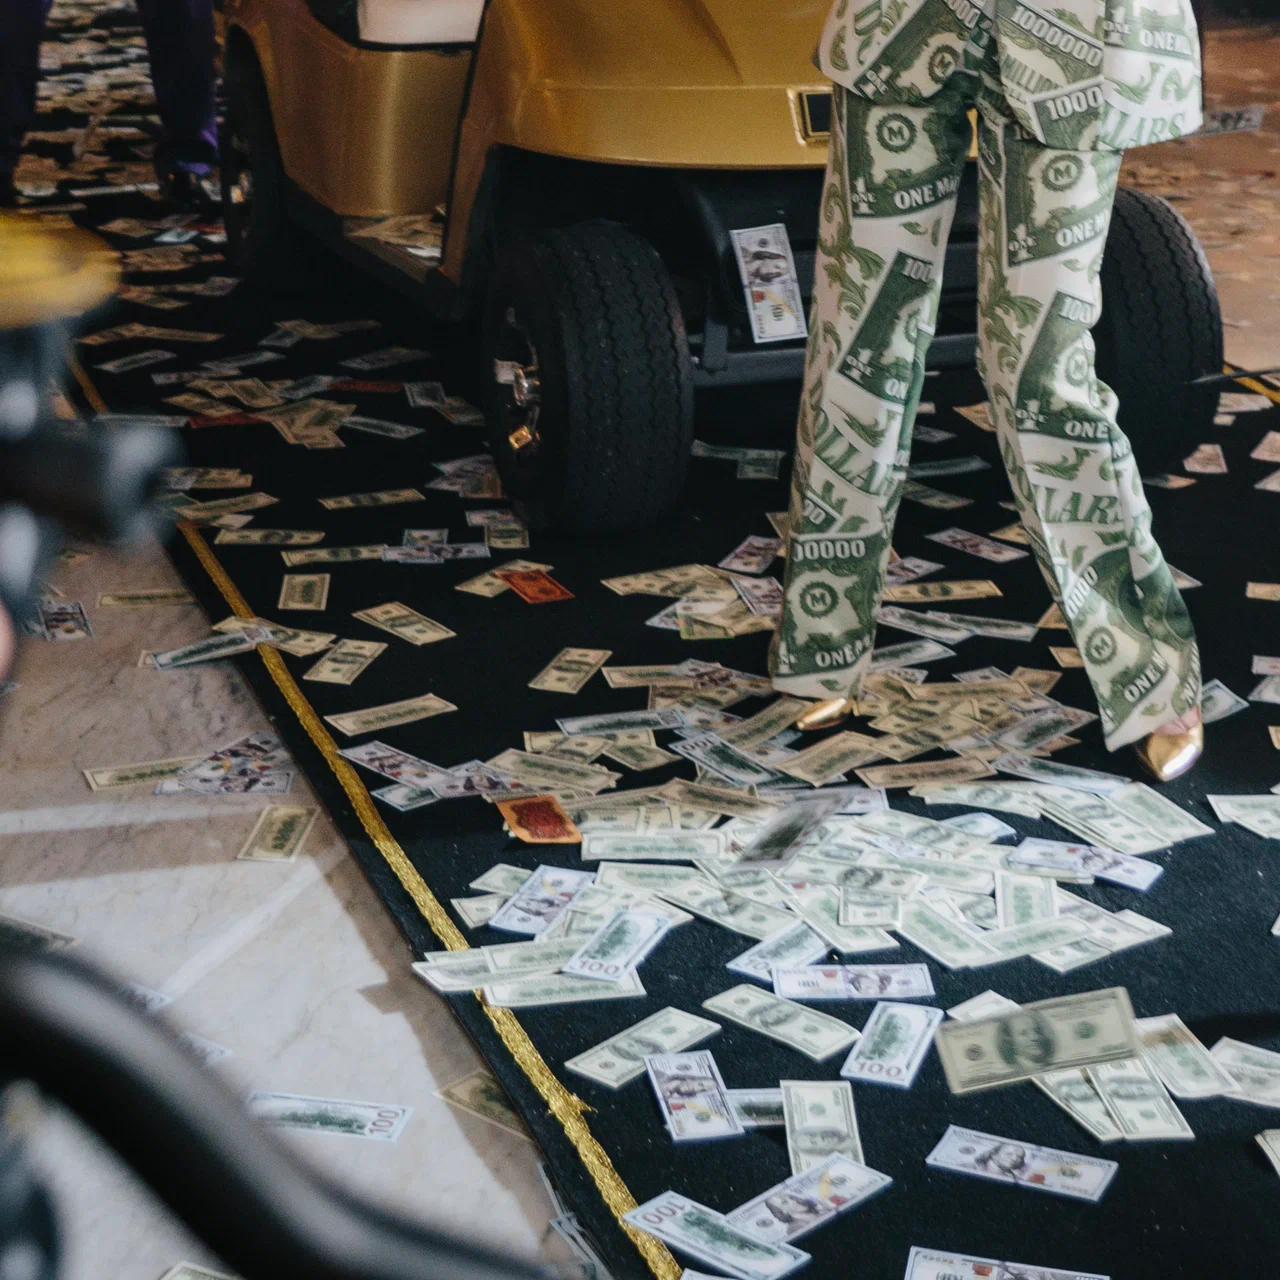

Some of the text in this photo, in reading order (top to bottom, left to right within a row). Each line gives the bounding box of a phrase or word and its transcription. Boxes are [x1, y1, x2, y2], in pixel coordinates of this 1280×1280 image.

[1012, 5, 1103, 67] 1000000
[1045, 86, 1104, 122] 1000
[894, 187, 935, 210] ONE
[1056, 223, 1094, 247] ONE
[1064, 419, 1109, 439] ONE
[815, 644, 853, 668] ONE
[1124, 665, 1160, 702] ONE
[579, 959, 619, 975] 100
[750, 958, 773, 971] 10
[858, 1062, 902, 1076] 100
[369, 1110, 400, 1134] 100
[641, 1197, 687, 1225] 100
